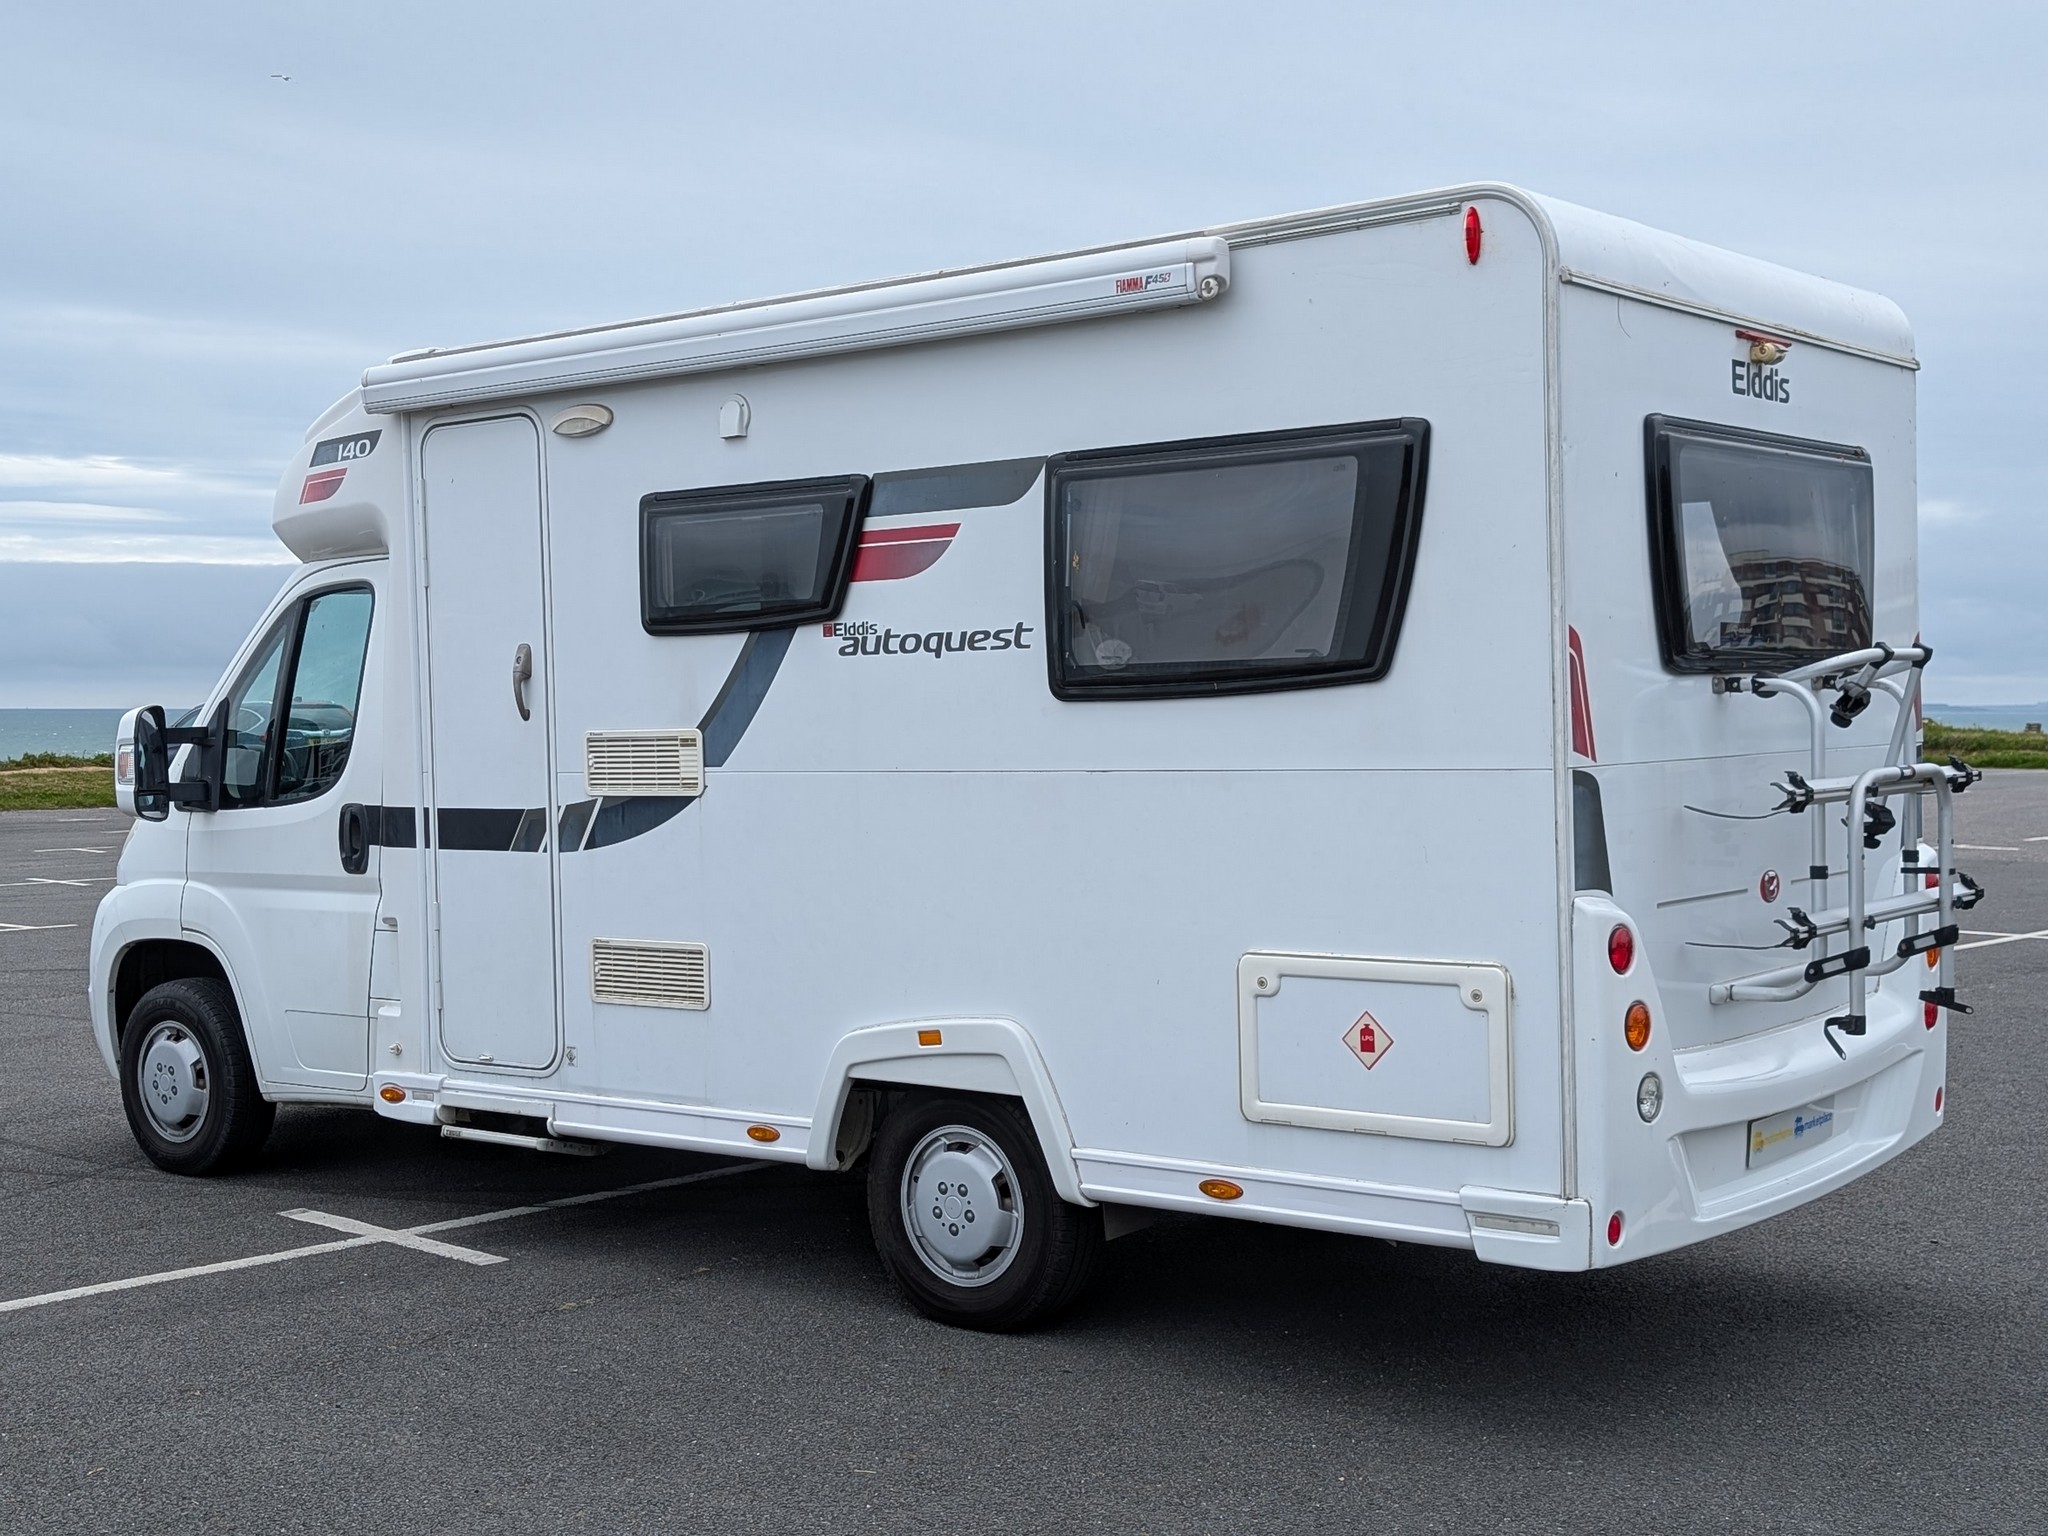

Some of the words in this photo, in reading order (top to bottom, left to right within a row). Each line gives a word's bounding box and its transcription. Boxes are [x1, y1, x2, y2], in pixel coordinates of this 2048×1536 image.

[1115, 276, 1143, 294] FIAMMA
[1731, 358, 1790, 404] Elddis
[337, 439, 371, 461] 140
[833, 621, 878, 636] Elddis
[838, 622, 1034, 659] autoquest
